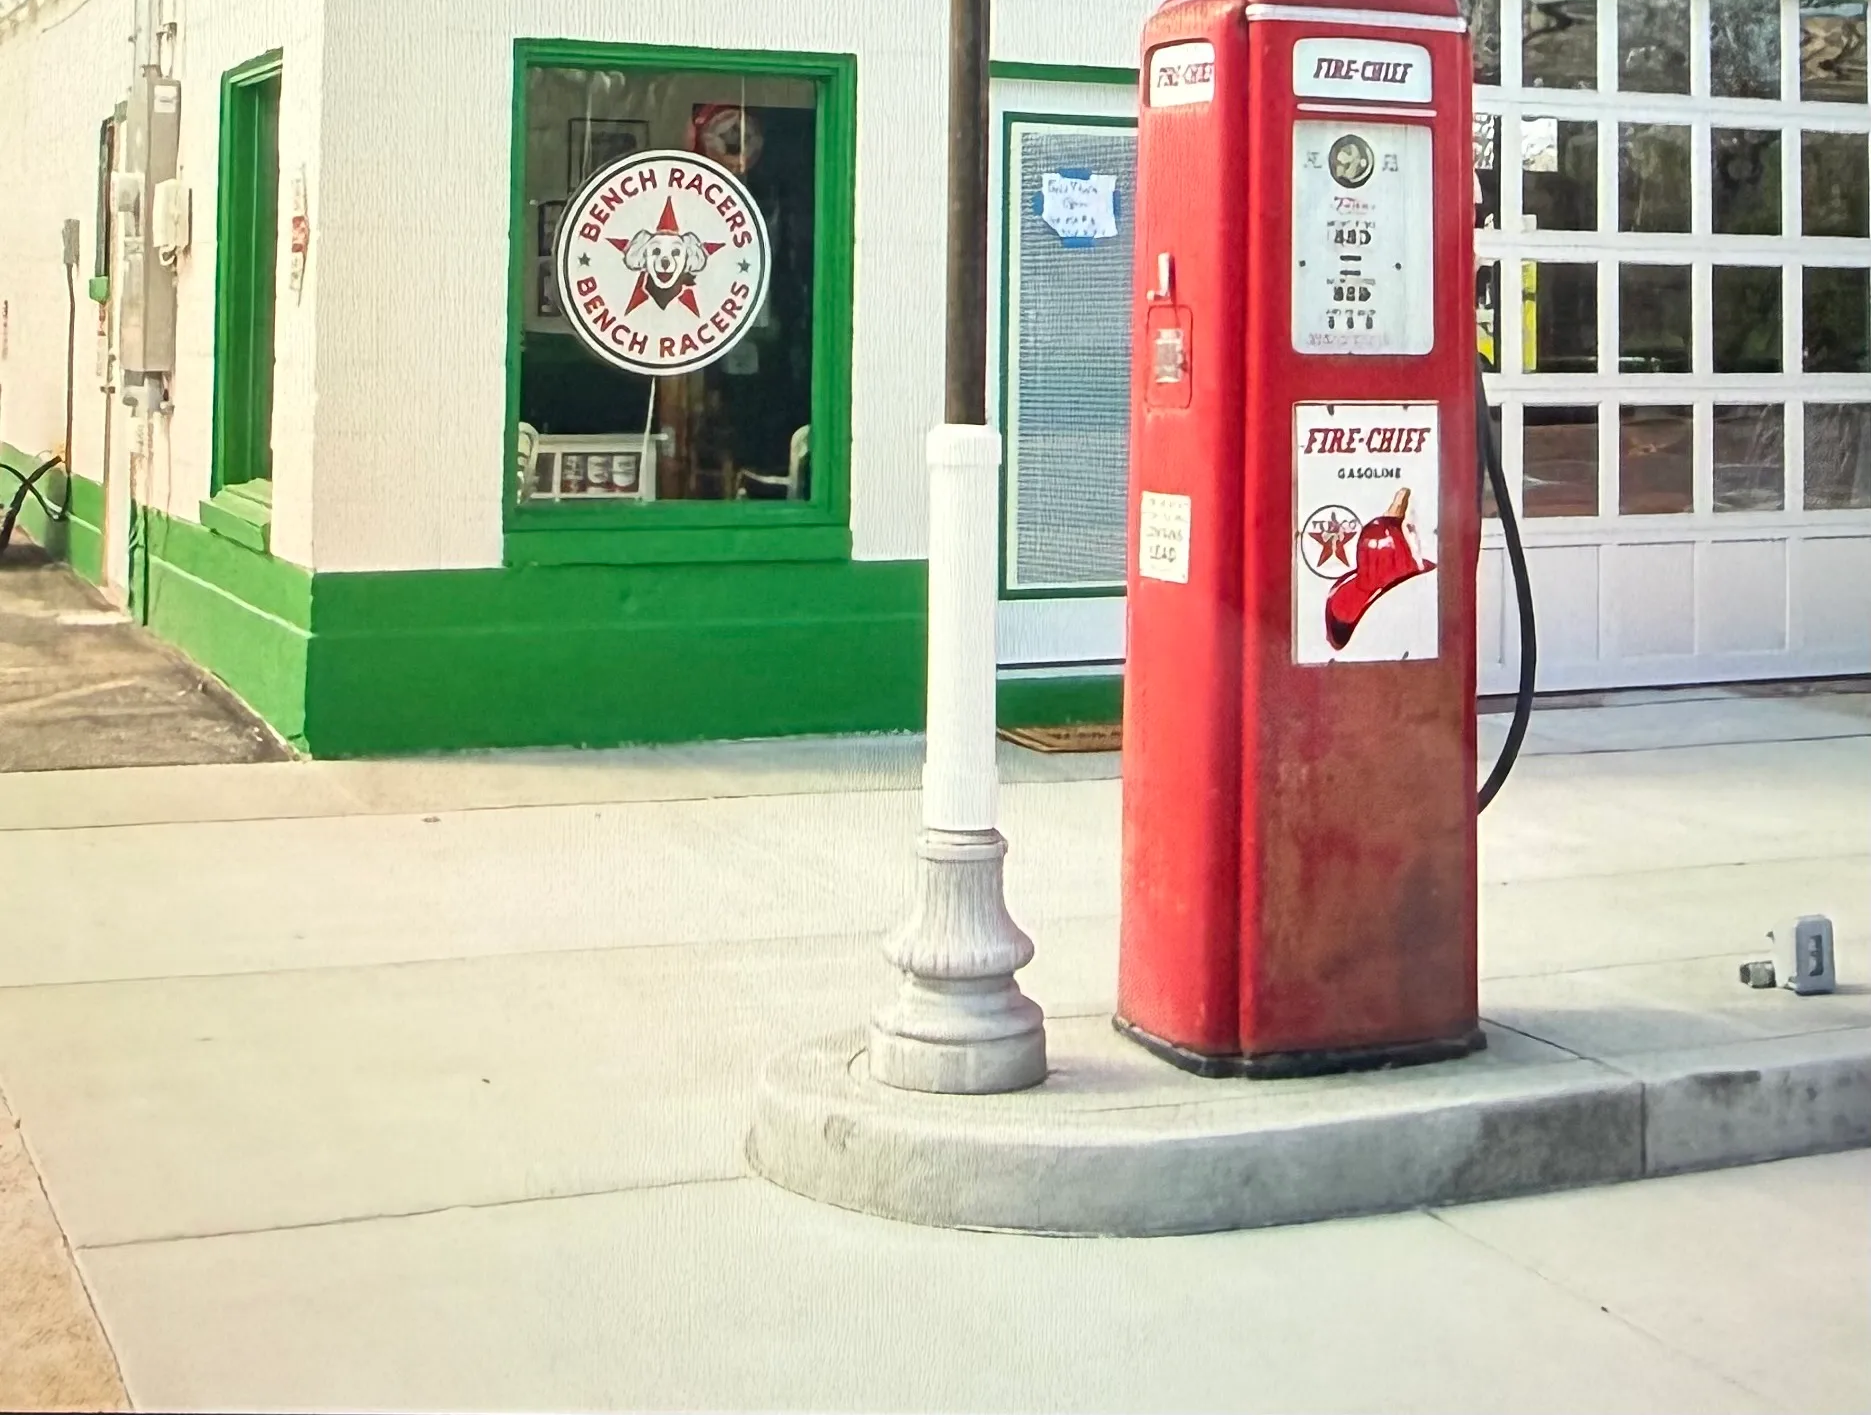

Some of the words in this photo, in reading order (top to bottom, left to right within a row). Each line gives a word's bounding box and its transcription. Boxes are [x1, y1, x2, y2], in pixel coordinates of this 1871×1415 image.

[1313, 57, 1414, 84] FIRE-CHIEF
[578, 168, 658, 243] BENCH
[667, 167, 753, 249] RACERS
[576, 276, 649, 355] BENCH
[658, 281, 751, 358] RACERS
[1303, 427, 1432, 455] FIRE-CHIEF
[1337, 467, 1402, 480] GASOLINE
